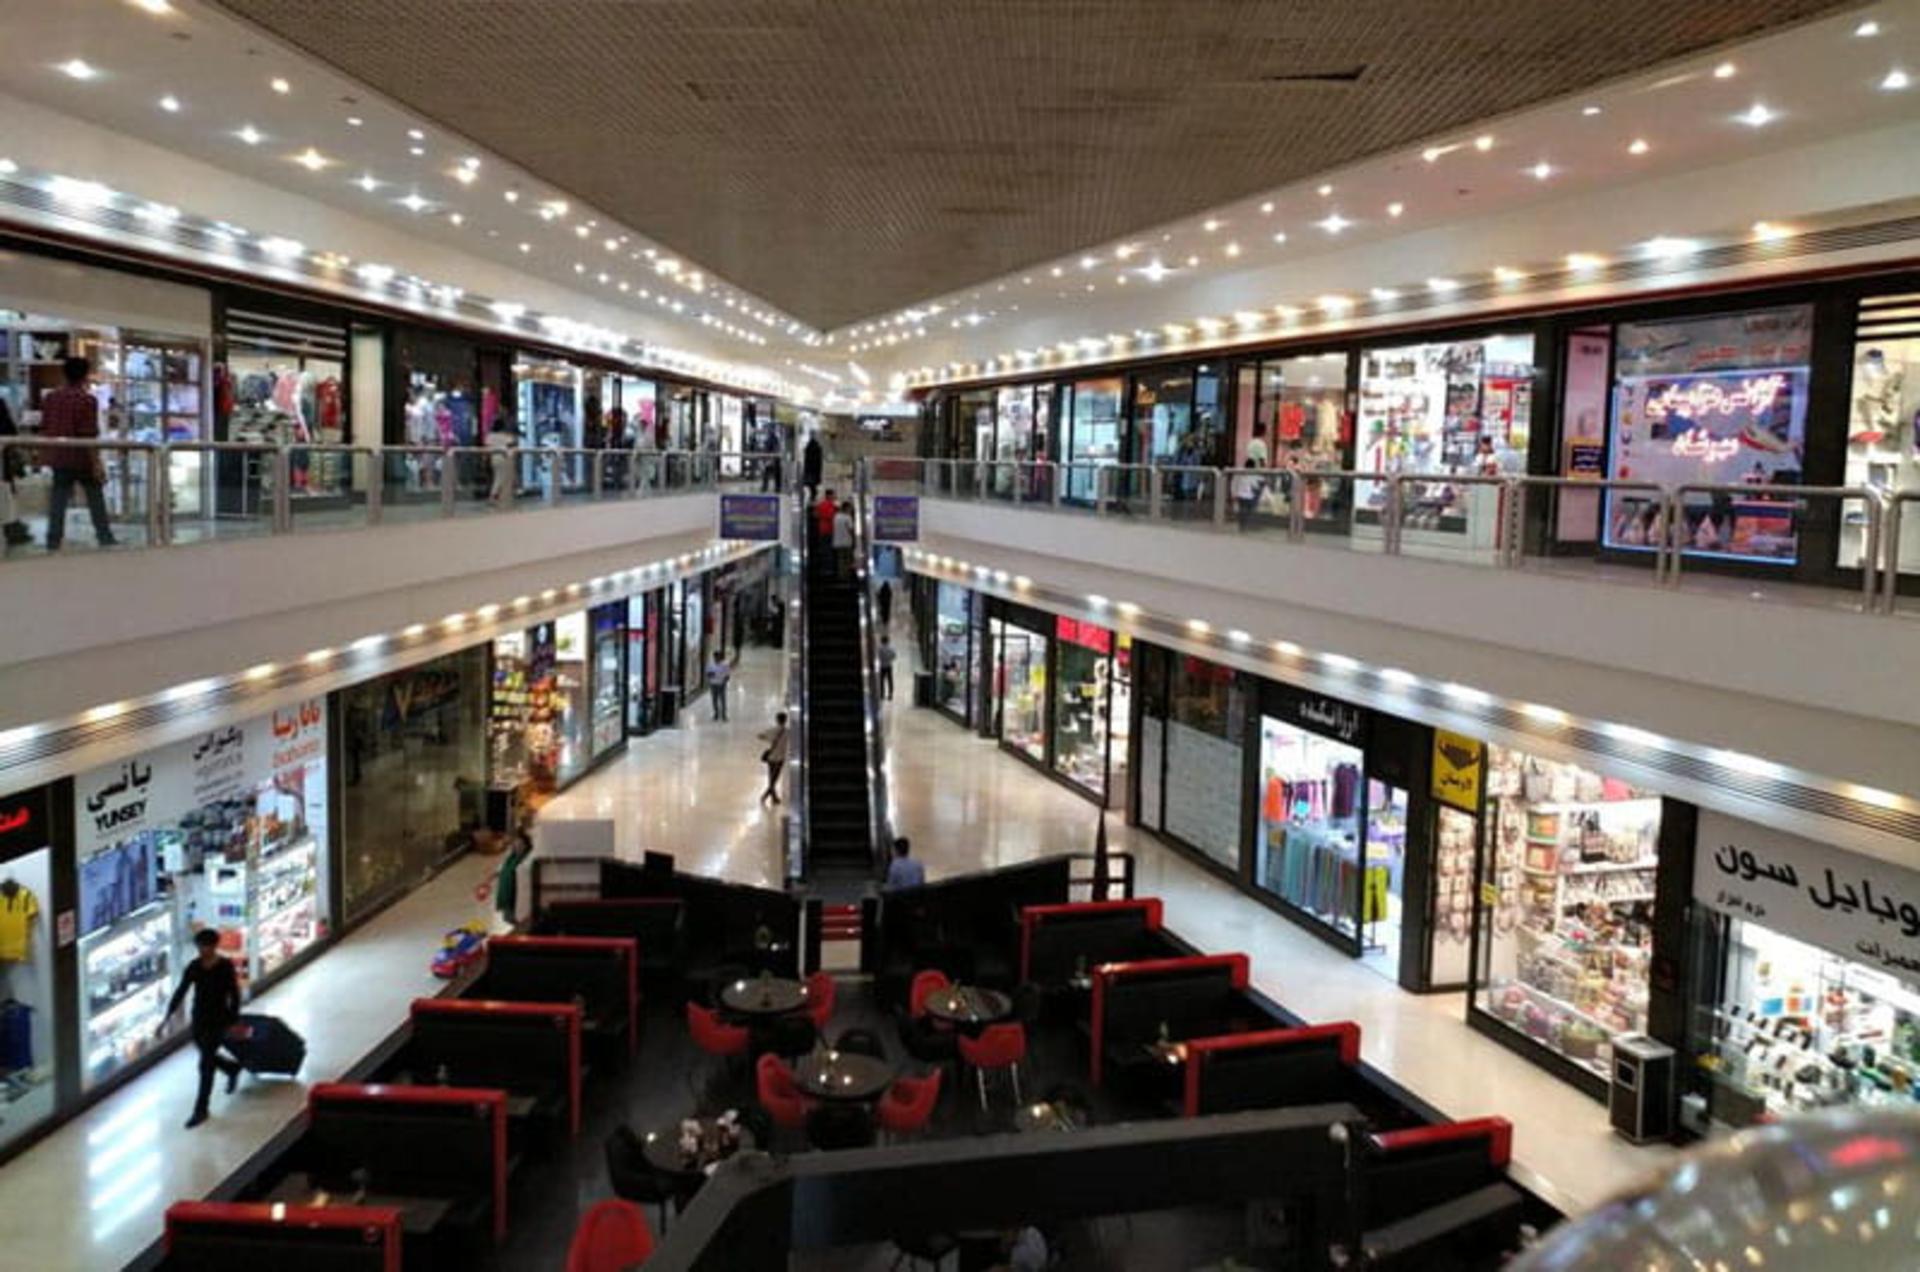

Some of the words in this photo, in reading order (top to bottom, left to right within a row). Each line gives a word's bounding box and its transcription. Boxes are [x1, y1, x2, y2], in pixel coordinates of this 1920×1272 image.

[94, 798, 147, 832] YUNSEY
[1714, 845, 1799, 887] سون
[1808, 868, 1920, 937] وبایل
